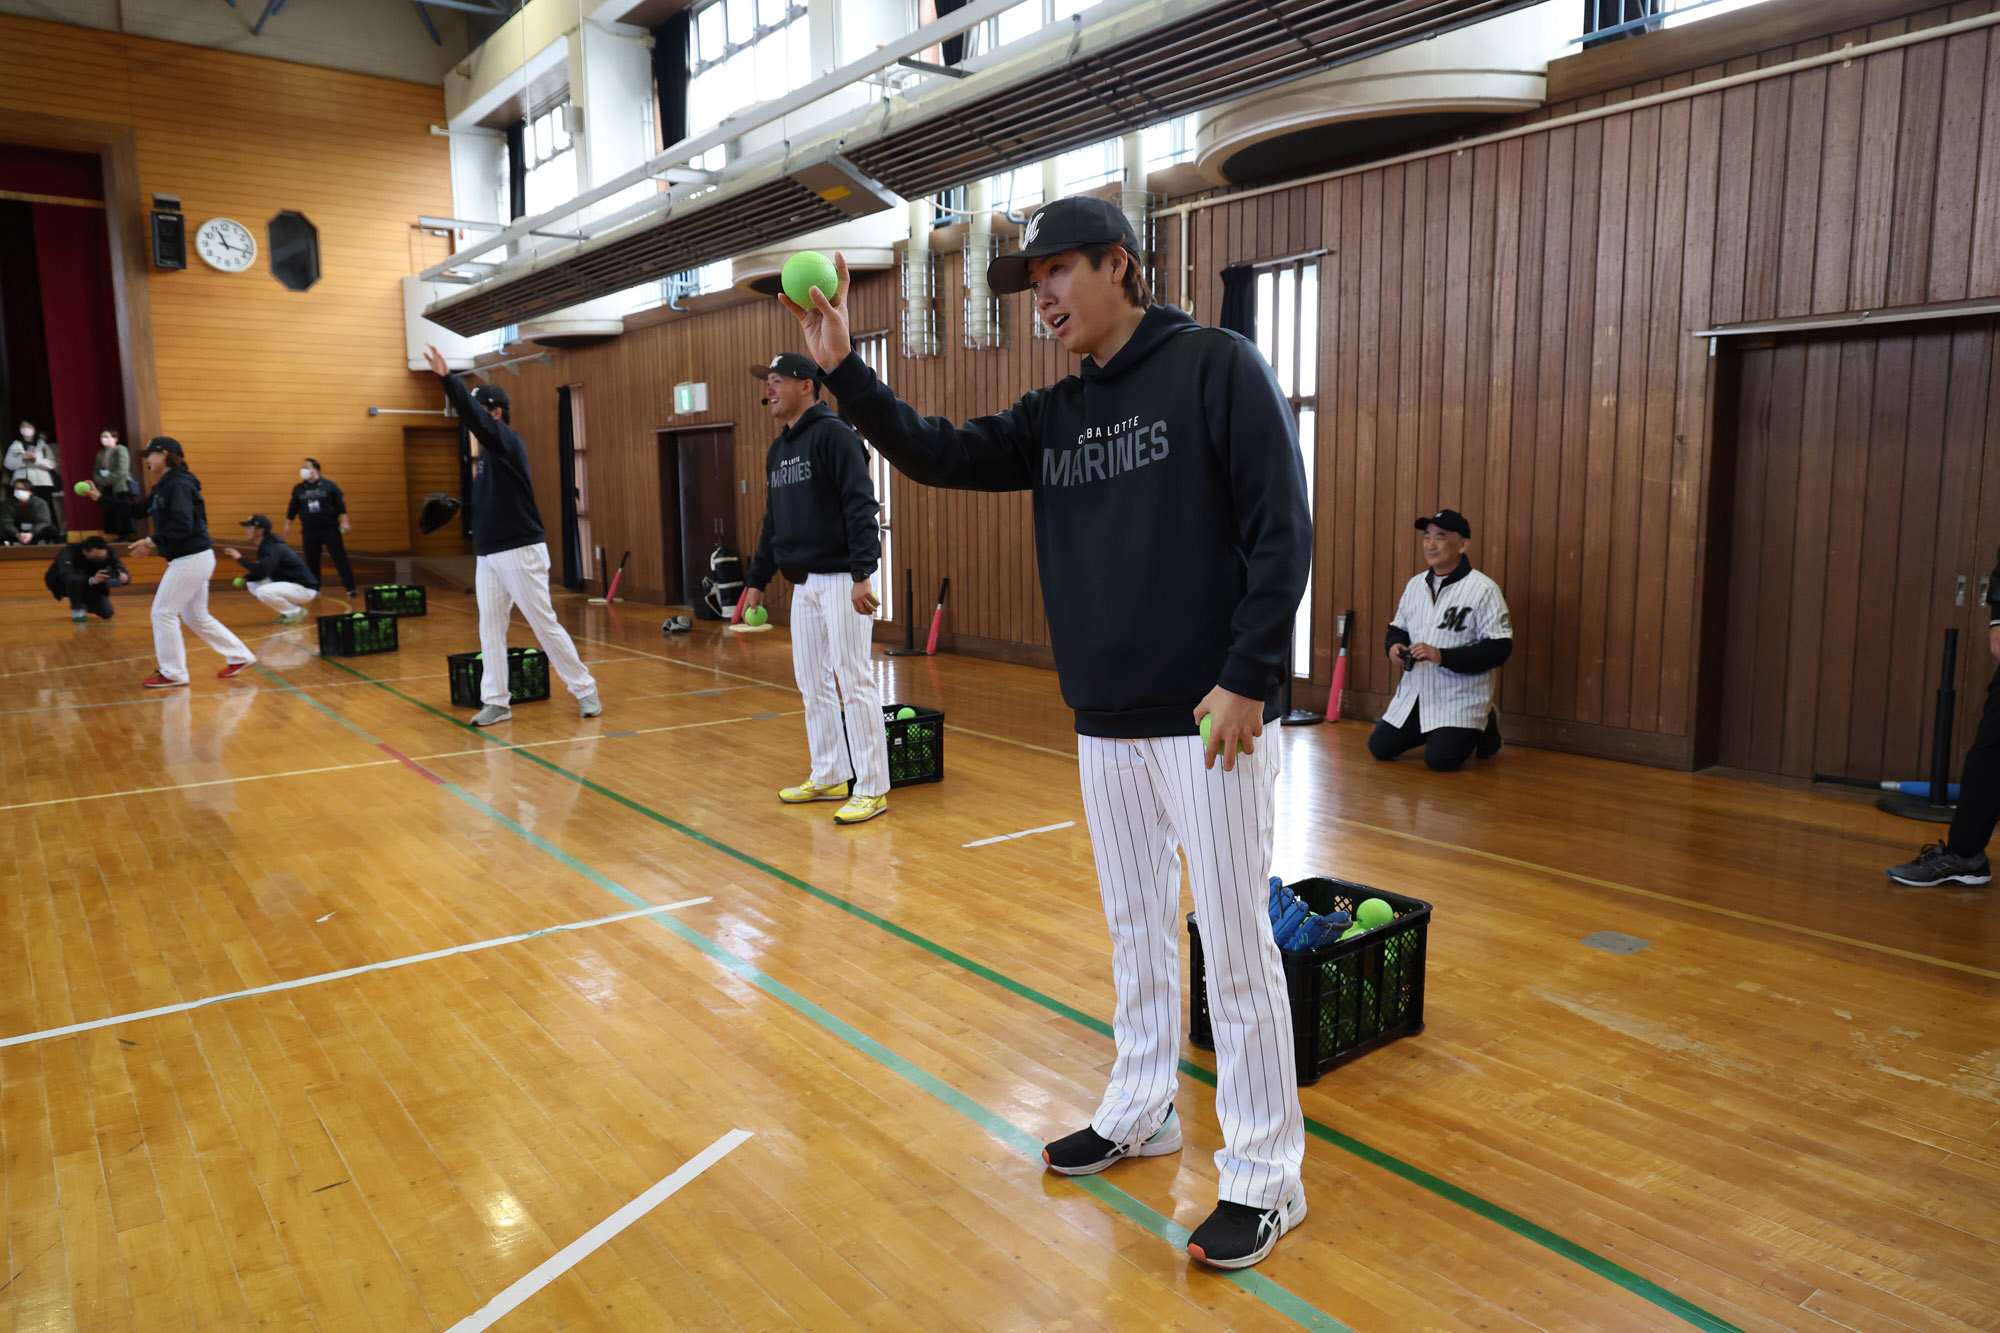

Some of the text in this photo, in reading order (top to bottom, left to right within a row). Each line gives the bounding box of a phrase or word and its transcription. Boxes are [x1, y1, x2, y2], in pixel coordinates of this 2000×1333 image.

[220, 223, 229, 231] 12
[204, 231, 213, 240] 10
[239, 233, 246, 242] 2
[206, 249, 213, 257] 8
[224, 259, 231, 267] 6
[1078, 416, 1139, 445] CBA LOTTE
[1043, 420, 1170, 487] MARINES
[1436, 605, 1473, 632] M
